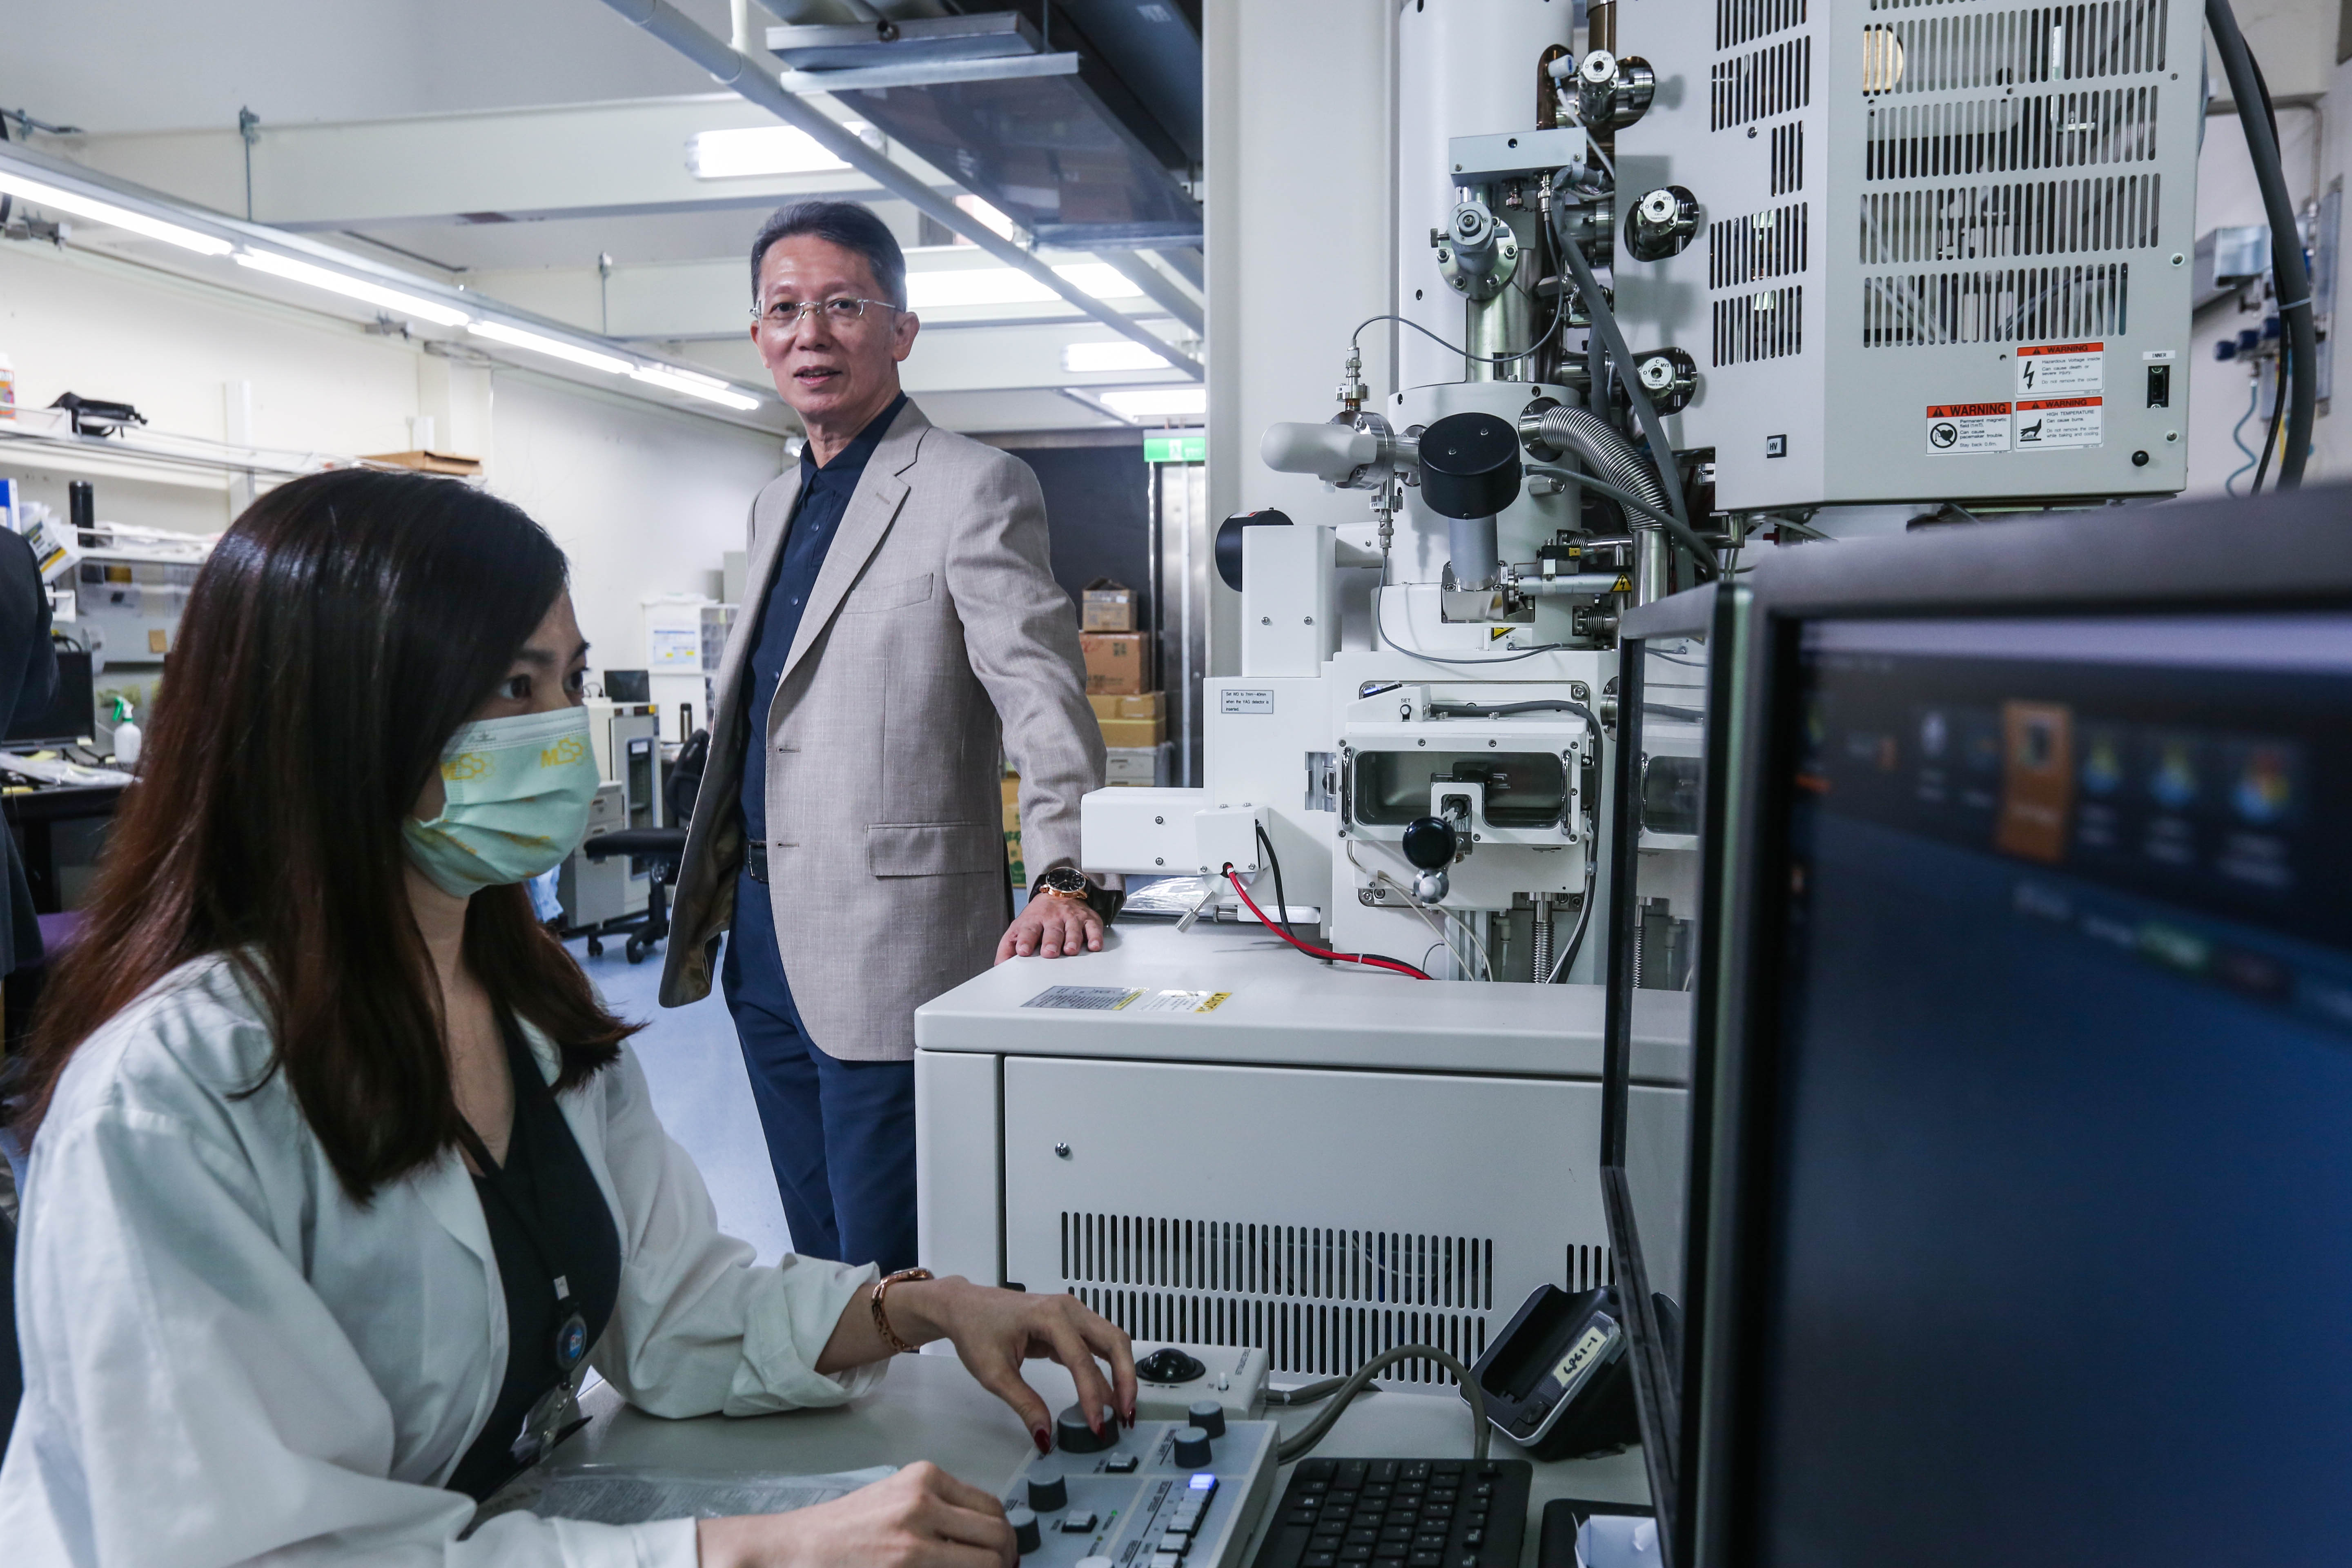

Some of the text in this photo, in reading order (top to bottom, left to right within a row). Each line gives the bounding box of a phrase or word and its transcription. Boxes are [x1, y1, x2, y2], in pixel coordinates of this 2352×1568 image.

[2045, 399, 2087, 408] WARNING
[1950, 404, 2006, 416] WARNING
[1769, 442, 1777, 451] HV
